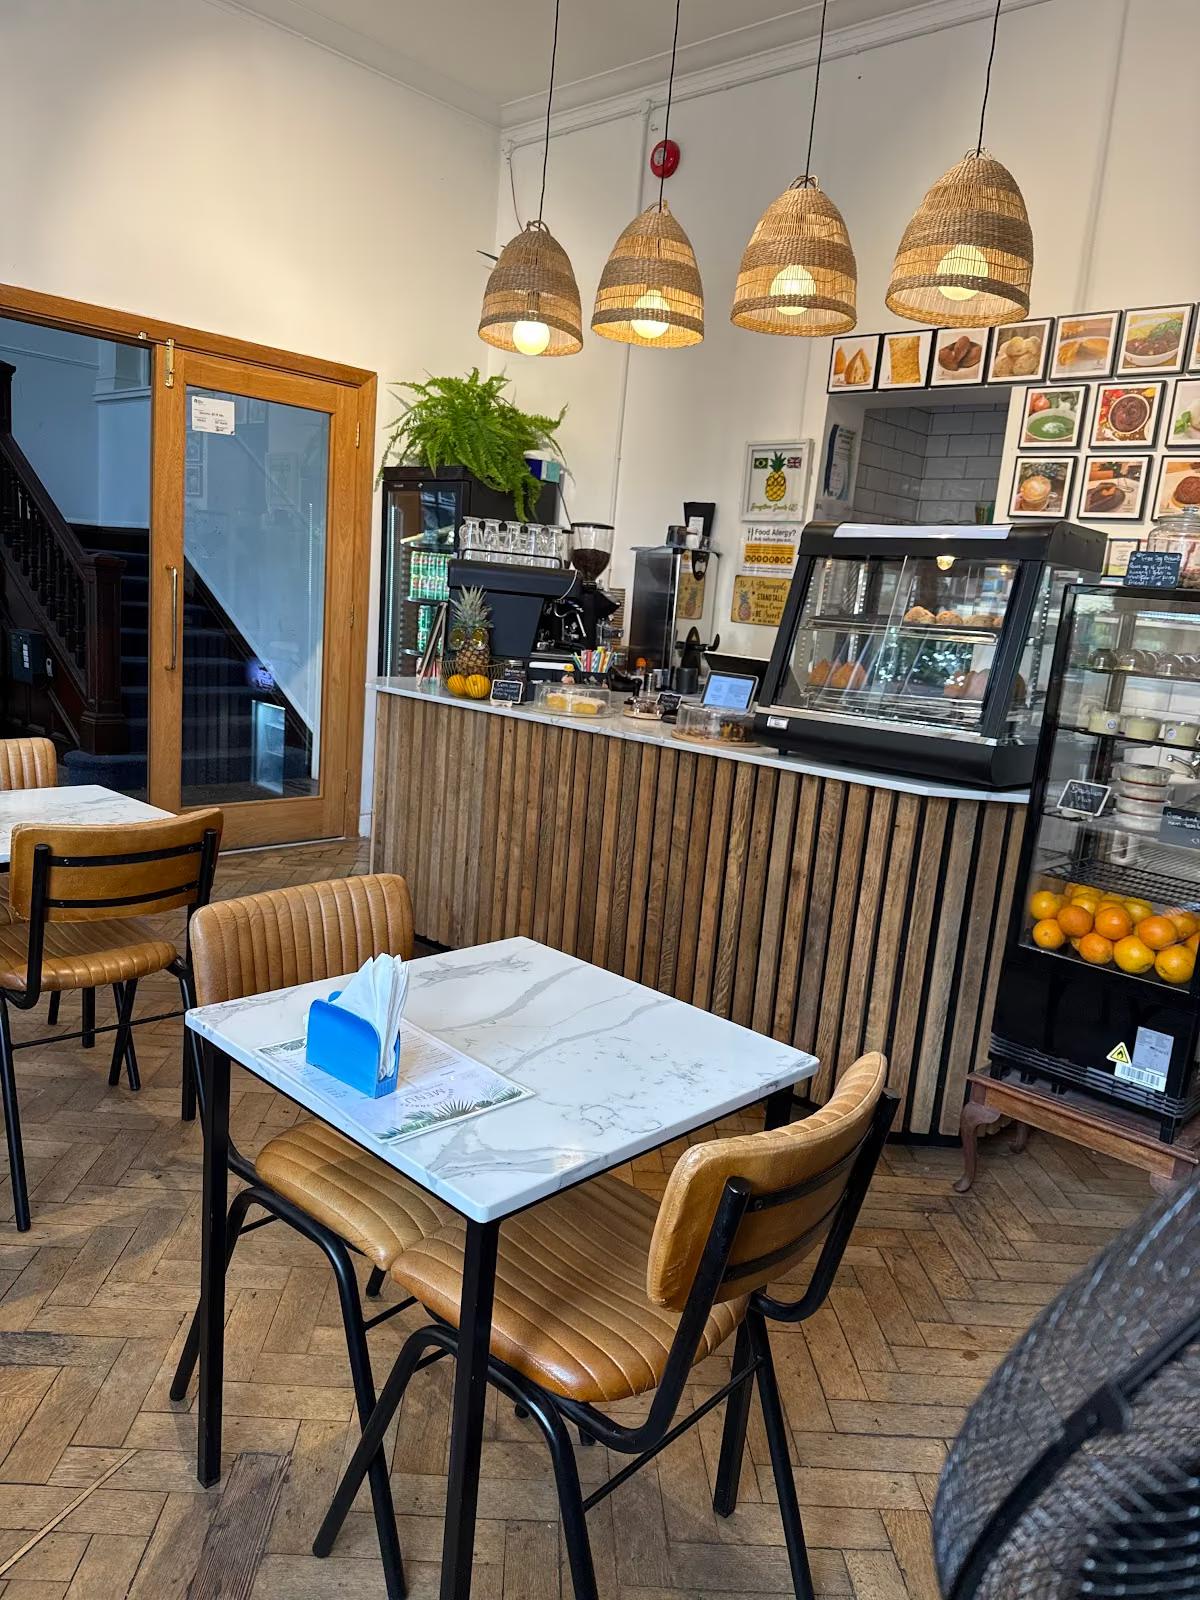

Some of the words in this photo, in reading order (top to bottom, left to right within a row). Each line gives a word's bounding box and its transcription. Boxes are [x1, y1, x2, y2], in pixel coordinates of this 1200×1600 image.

[754, 528, 770, 536] Food
[772, 528, 797, 538] Allergy?
[757, 593, 772, 601] STAND
[772, 594, 784, 602] TALL
[404, 1088, 446, 1104] MENU
